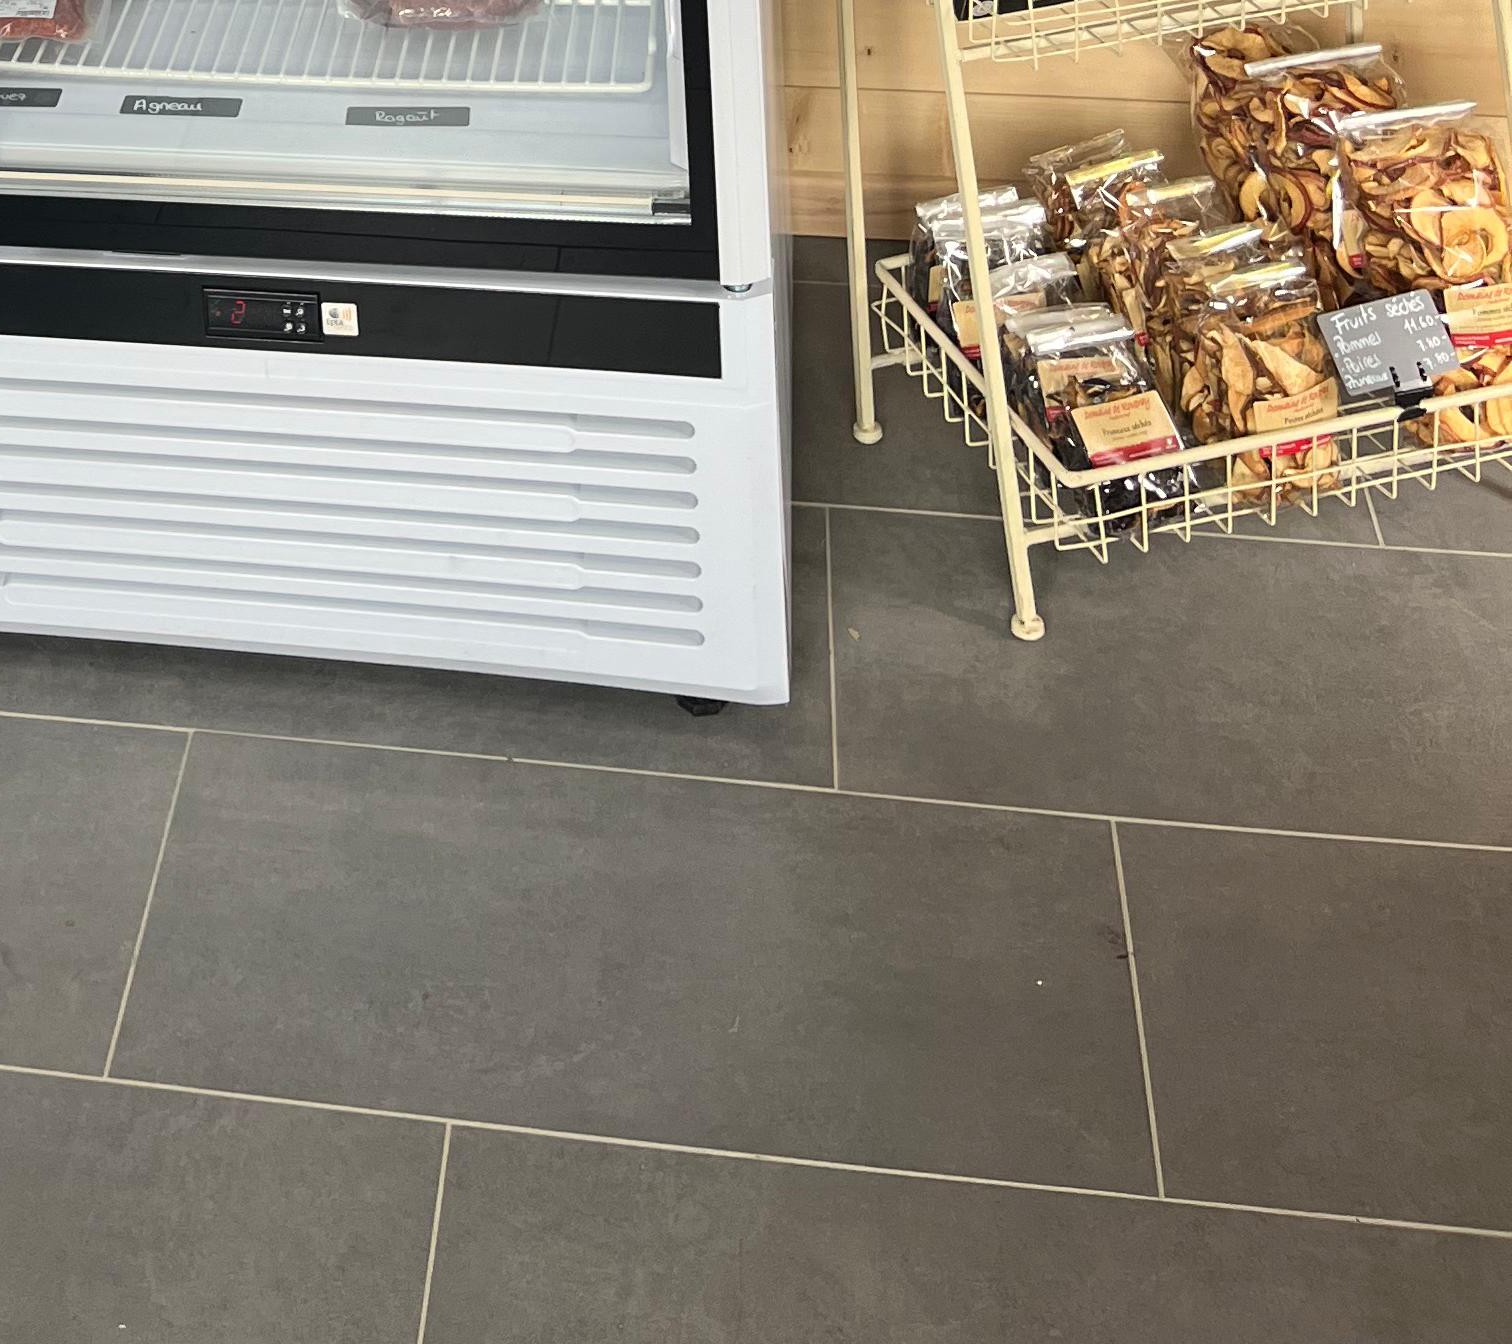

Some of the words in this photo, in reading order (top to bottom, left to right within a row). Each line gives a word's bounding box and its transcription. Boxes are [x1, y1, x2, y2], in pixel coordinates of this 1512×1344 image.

[133, 99, 203, 114] Agneau
[1330, 304, 1376, 334] Fruits
[1333, 331, 1382, 355] Pommes
[1343, 354, 1382, 374] Poires
